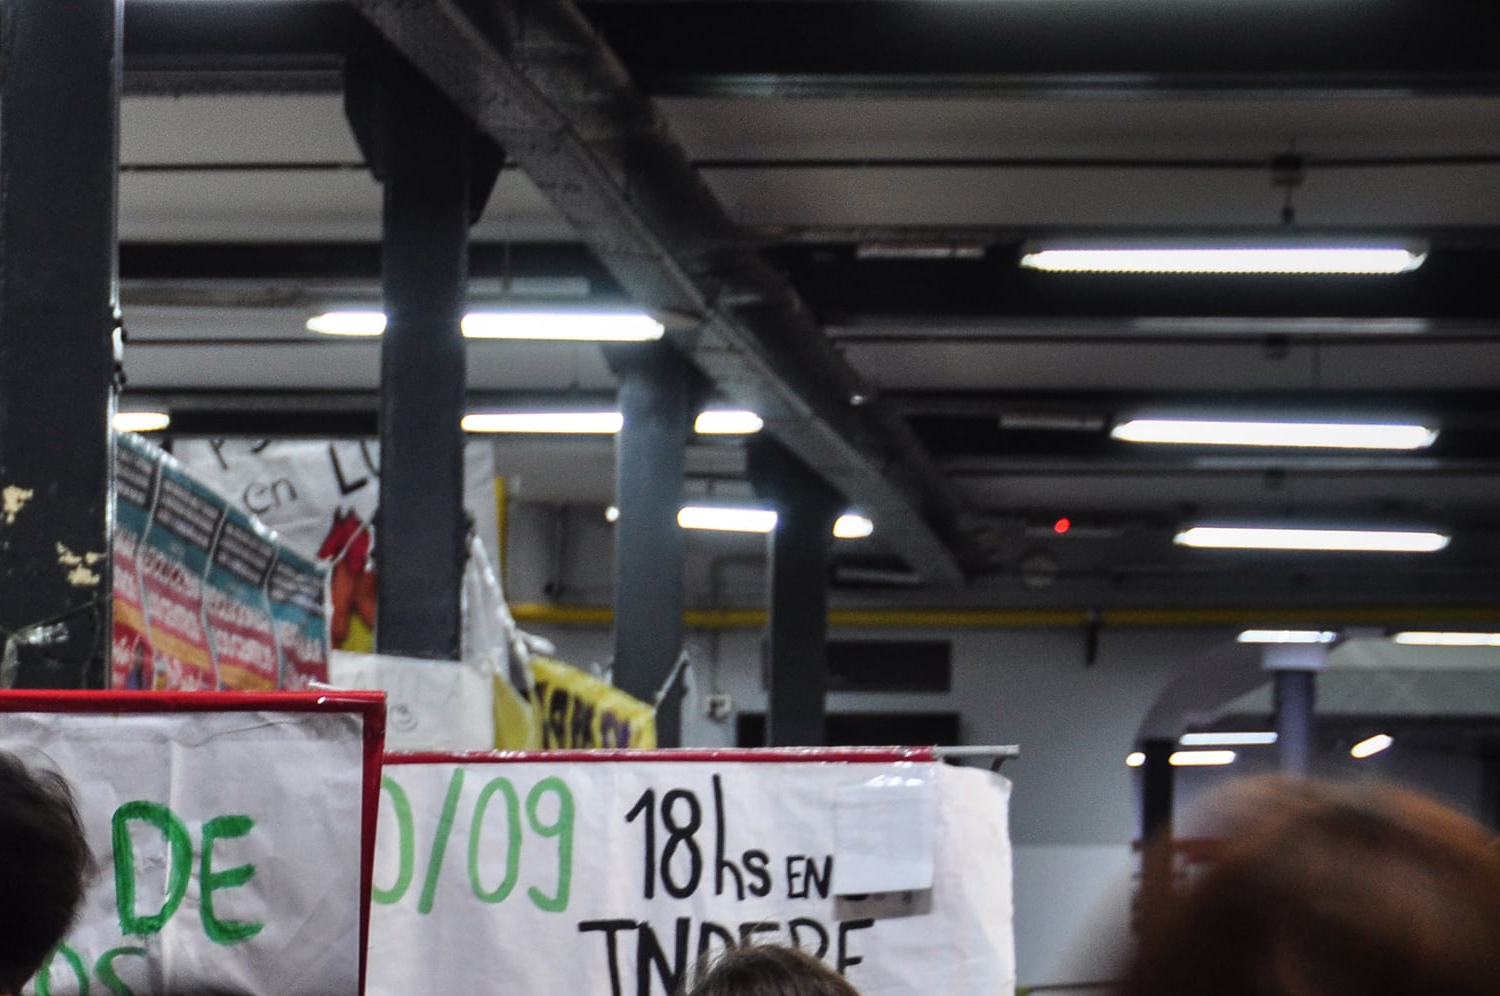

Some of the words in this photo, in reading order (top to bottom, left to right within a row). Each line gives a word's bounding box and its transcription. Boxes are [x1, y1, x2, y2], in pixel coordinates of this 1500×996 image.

[110, 799, 264, 945] DE
[625, 774, 772, 900] 18hs
[786, 854, 834, 899] EN
